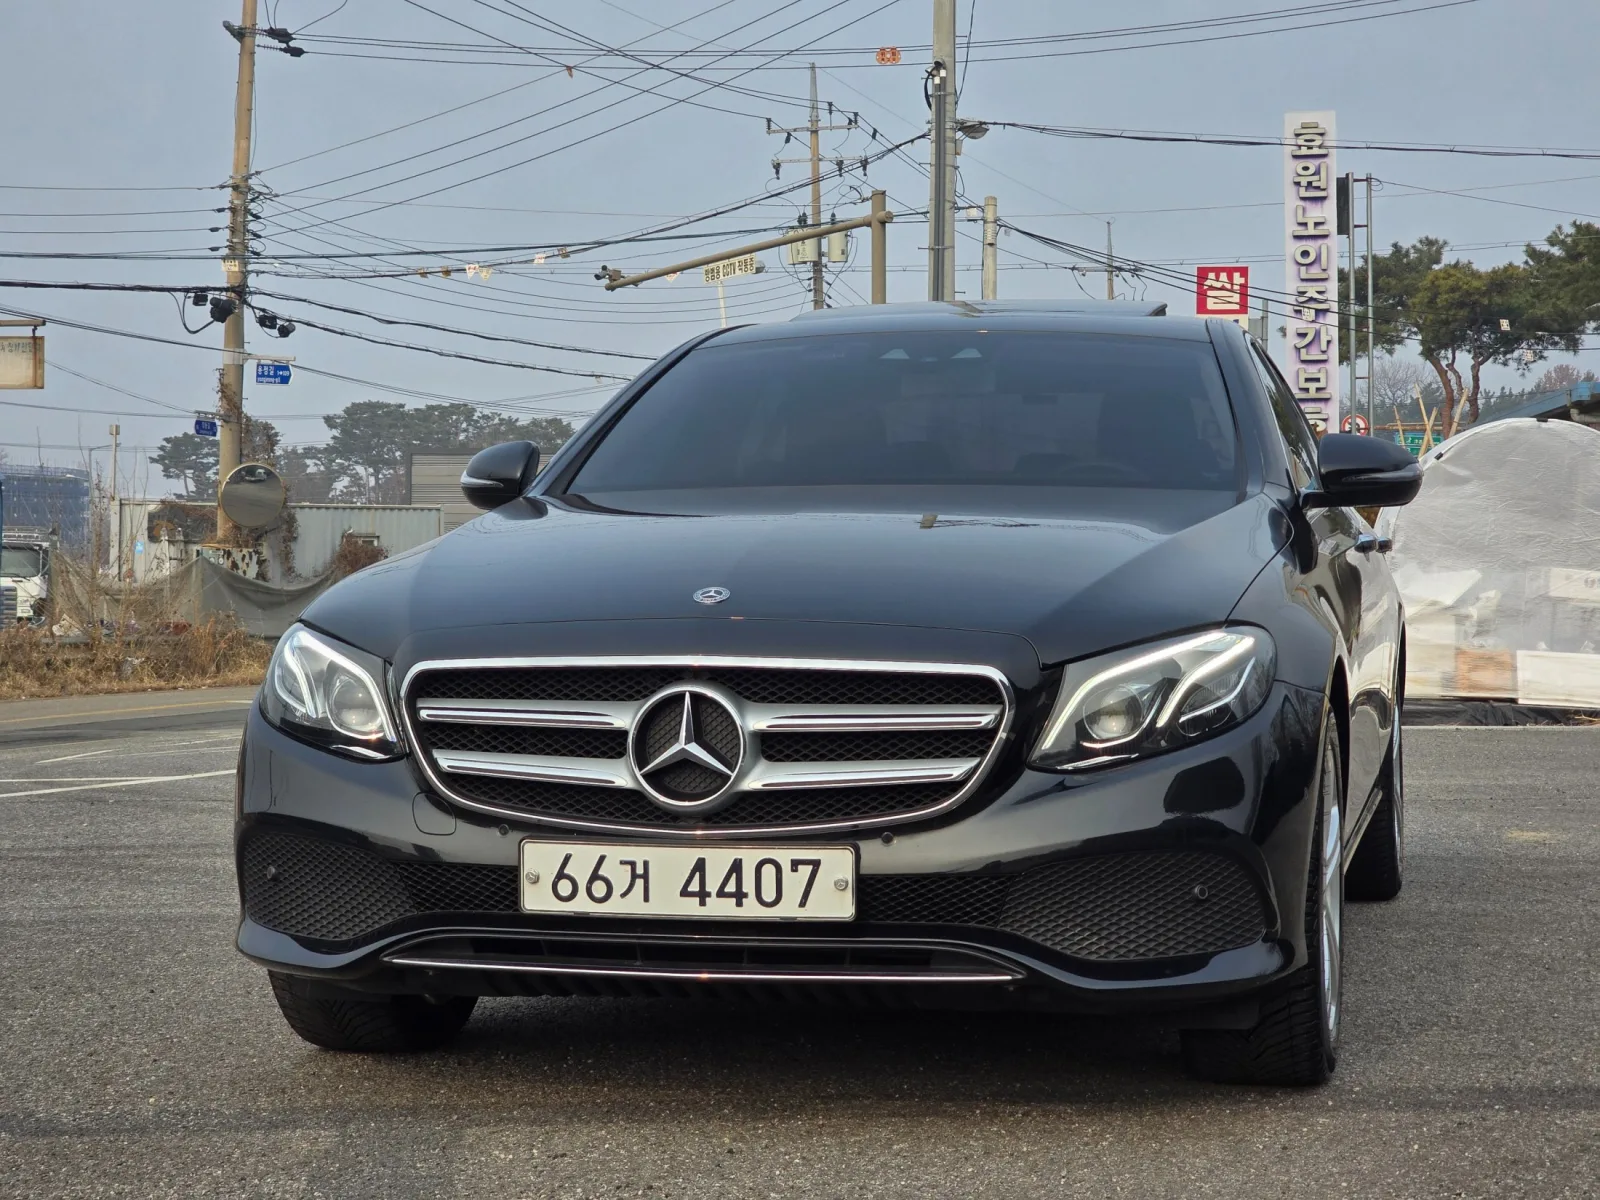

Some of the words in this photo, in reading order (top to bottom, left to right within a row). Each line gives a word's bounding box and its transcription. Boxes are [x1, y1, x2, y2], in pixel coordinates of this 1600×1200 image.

[705, 265, 720, 282] 방범용
[722, 261, 737, 277] CCTV
[737, 257, 754, 273] 작동중
[1203, 272, 1245, 310] 쌀
[551, 853, 650, 904] 66거
[679, 856, 822, 908] 4407
